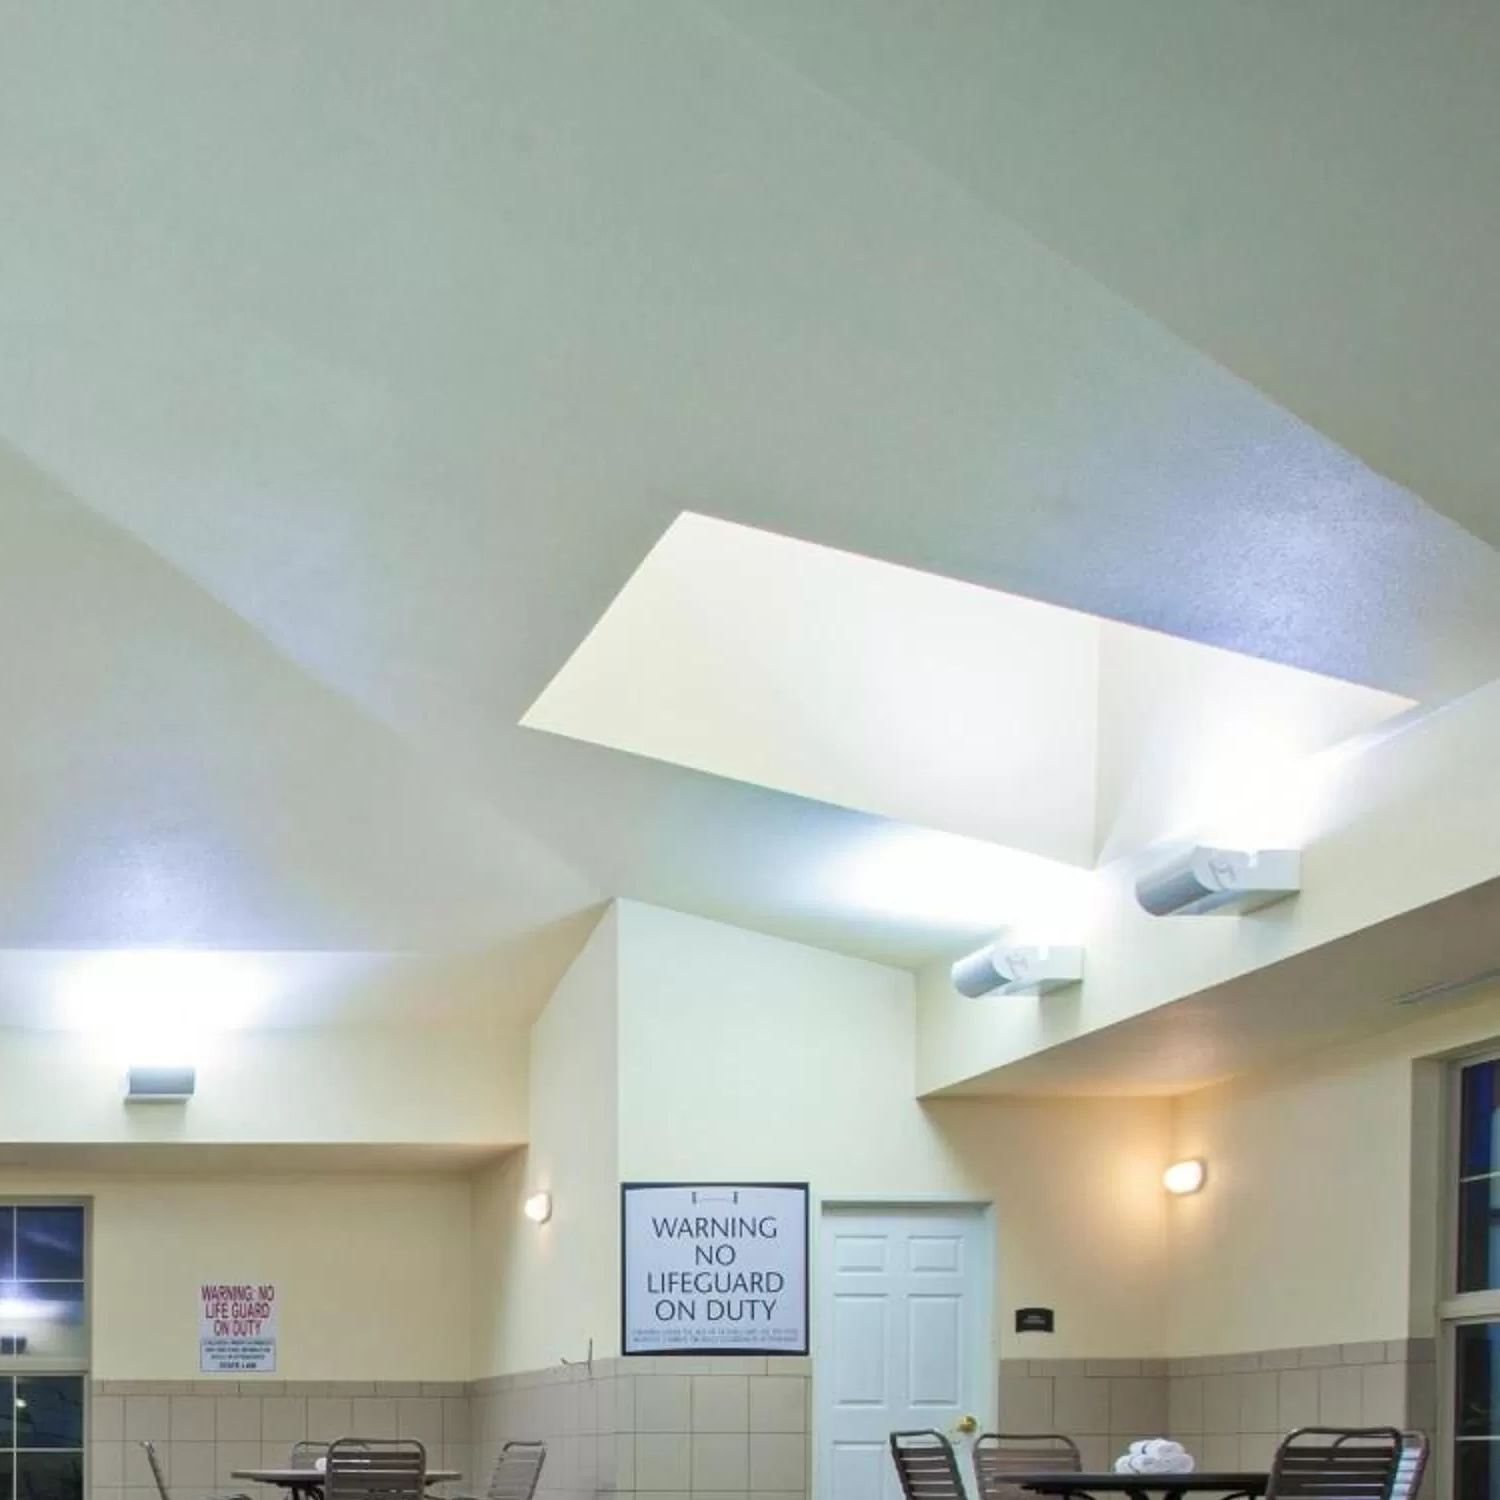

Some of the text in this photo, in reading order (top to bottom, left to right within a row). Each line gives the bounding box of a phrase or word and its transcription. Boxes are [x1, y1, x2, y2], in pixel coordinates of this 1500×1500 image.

[651, 1216, 778, 1239] WARNING
[694, 1244, 737, 1266] NO
[258, 1285, 275, 1301] NO
[647, 1271, 784, 1294] LIFEGUARD
[205, 1302, 271, 1319] LIFE GUARD
[655, 1299, 778, 1321] ON DUTY
[213, 1320, 262, 1336] ON DUTY
